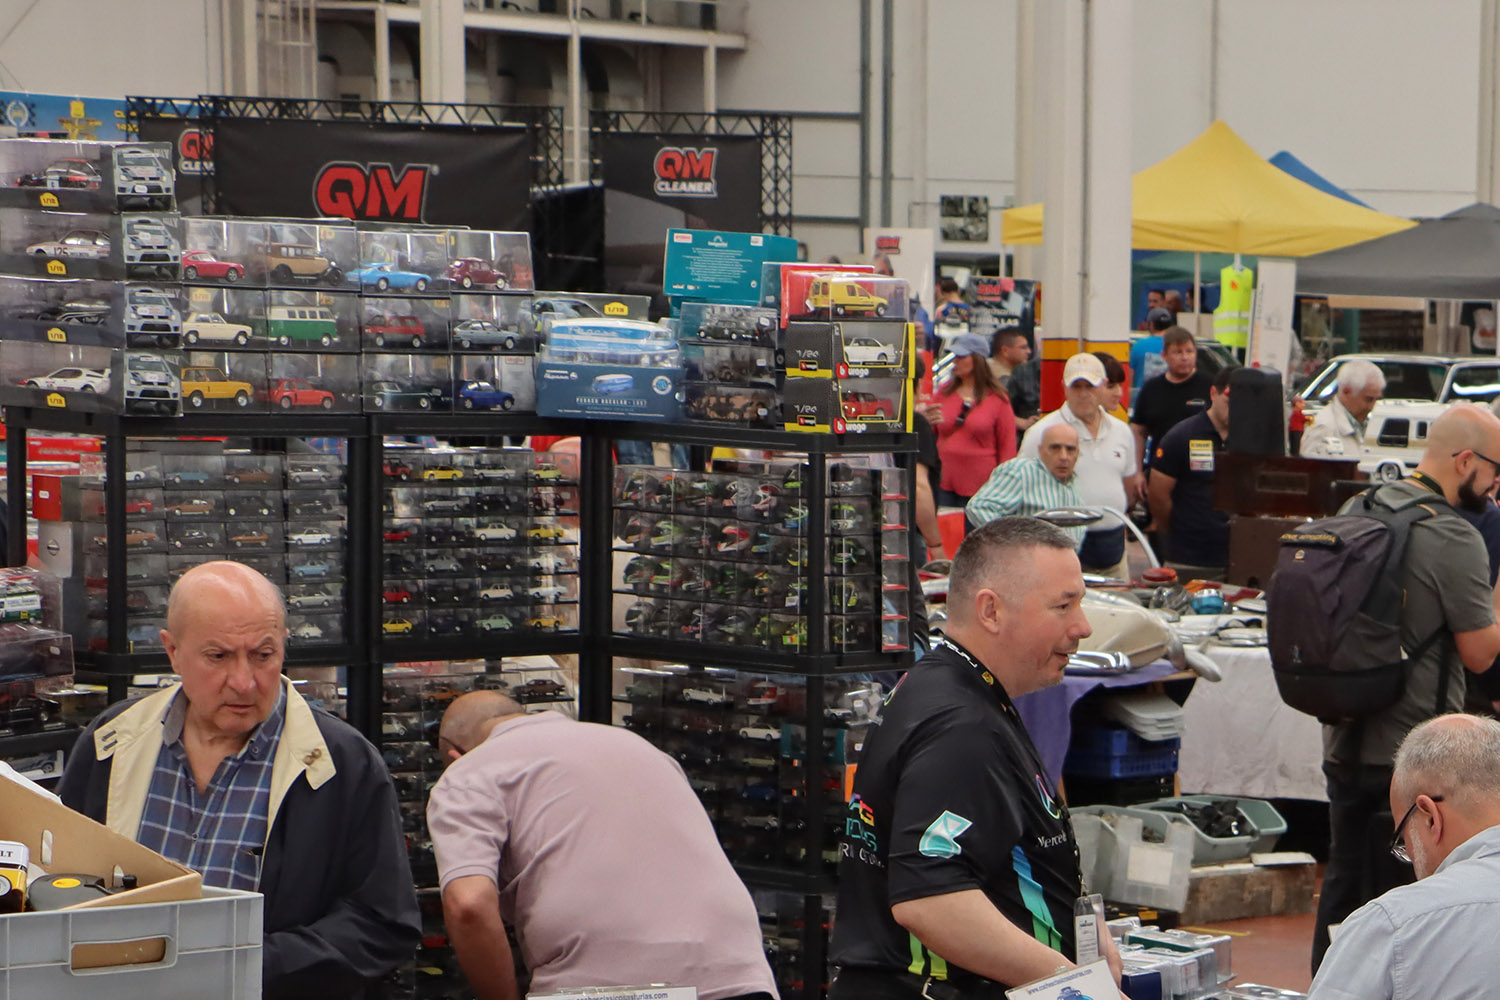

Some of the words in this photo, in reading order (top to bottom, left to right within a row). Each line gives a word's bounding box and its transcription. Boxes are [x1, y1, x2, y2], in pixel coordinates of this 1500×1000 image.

[656, 148, 716, 180] QM
[314, 162, 429, 220] QM
[656, 181, 713, 194] CLEANER
